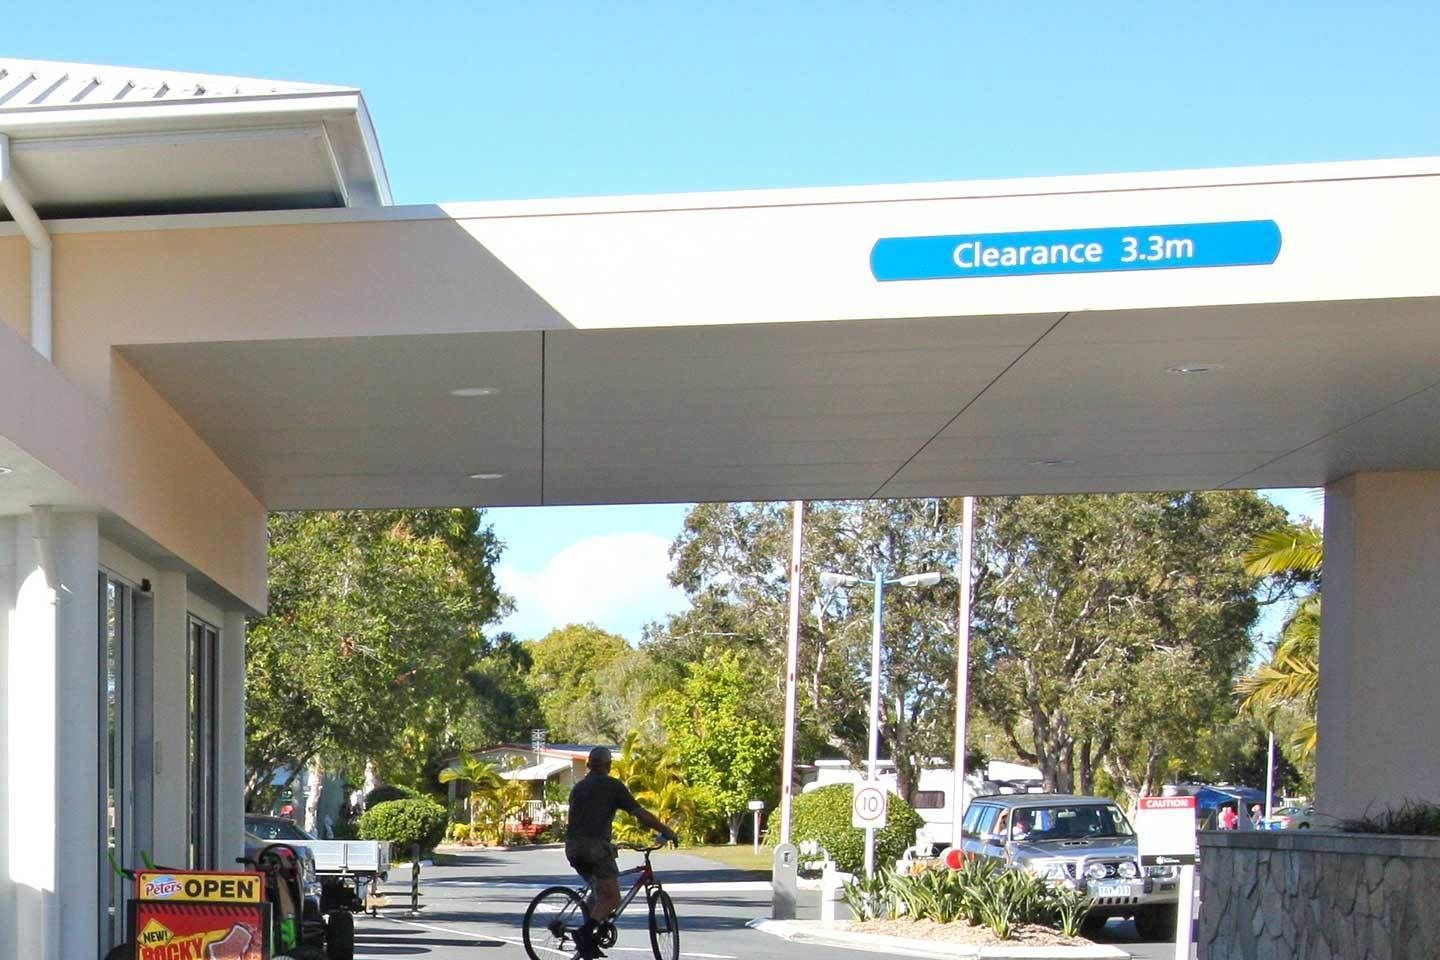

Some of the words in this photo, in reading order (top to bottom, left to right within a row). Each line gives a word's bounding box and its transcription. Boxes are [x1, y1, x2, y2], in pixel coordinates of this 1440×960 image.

[953, 241, 1102, 269] Clearance
[1120, 236, 1194, 263] 3.3m
[863, 796, 878, 812] 10
[1146, 799, 1188, 808] CAUTION
[146, 881, 183, 896] Peters
[184, 880, 254, 898] OPEN
[143, 930, 168, 944] NEW!
